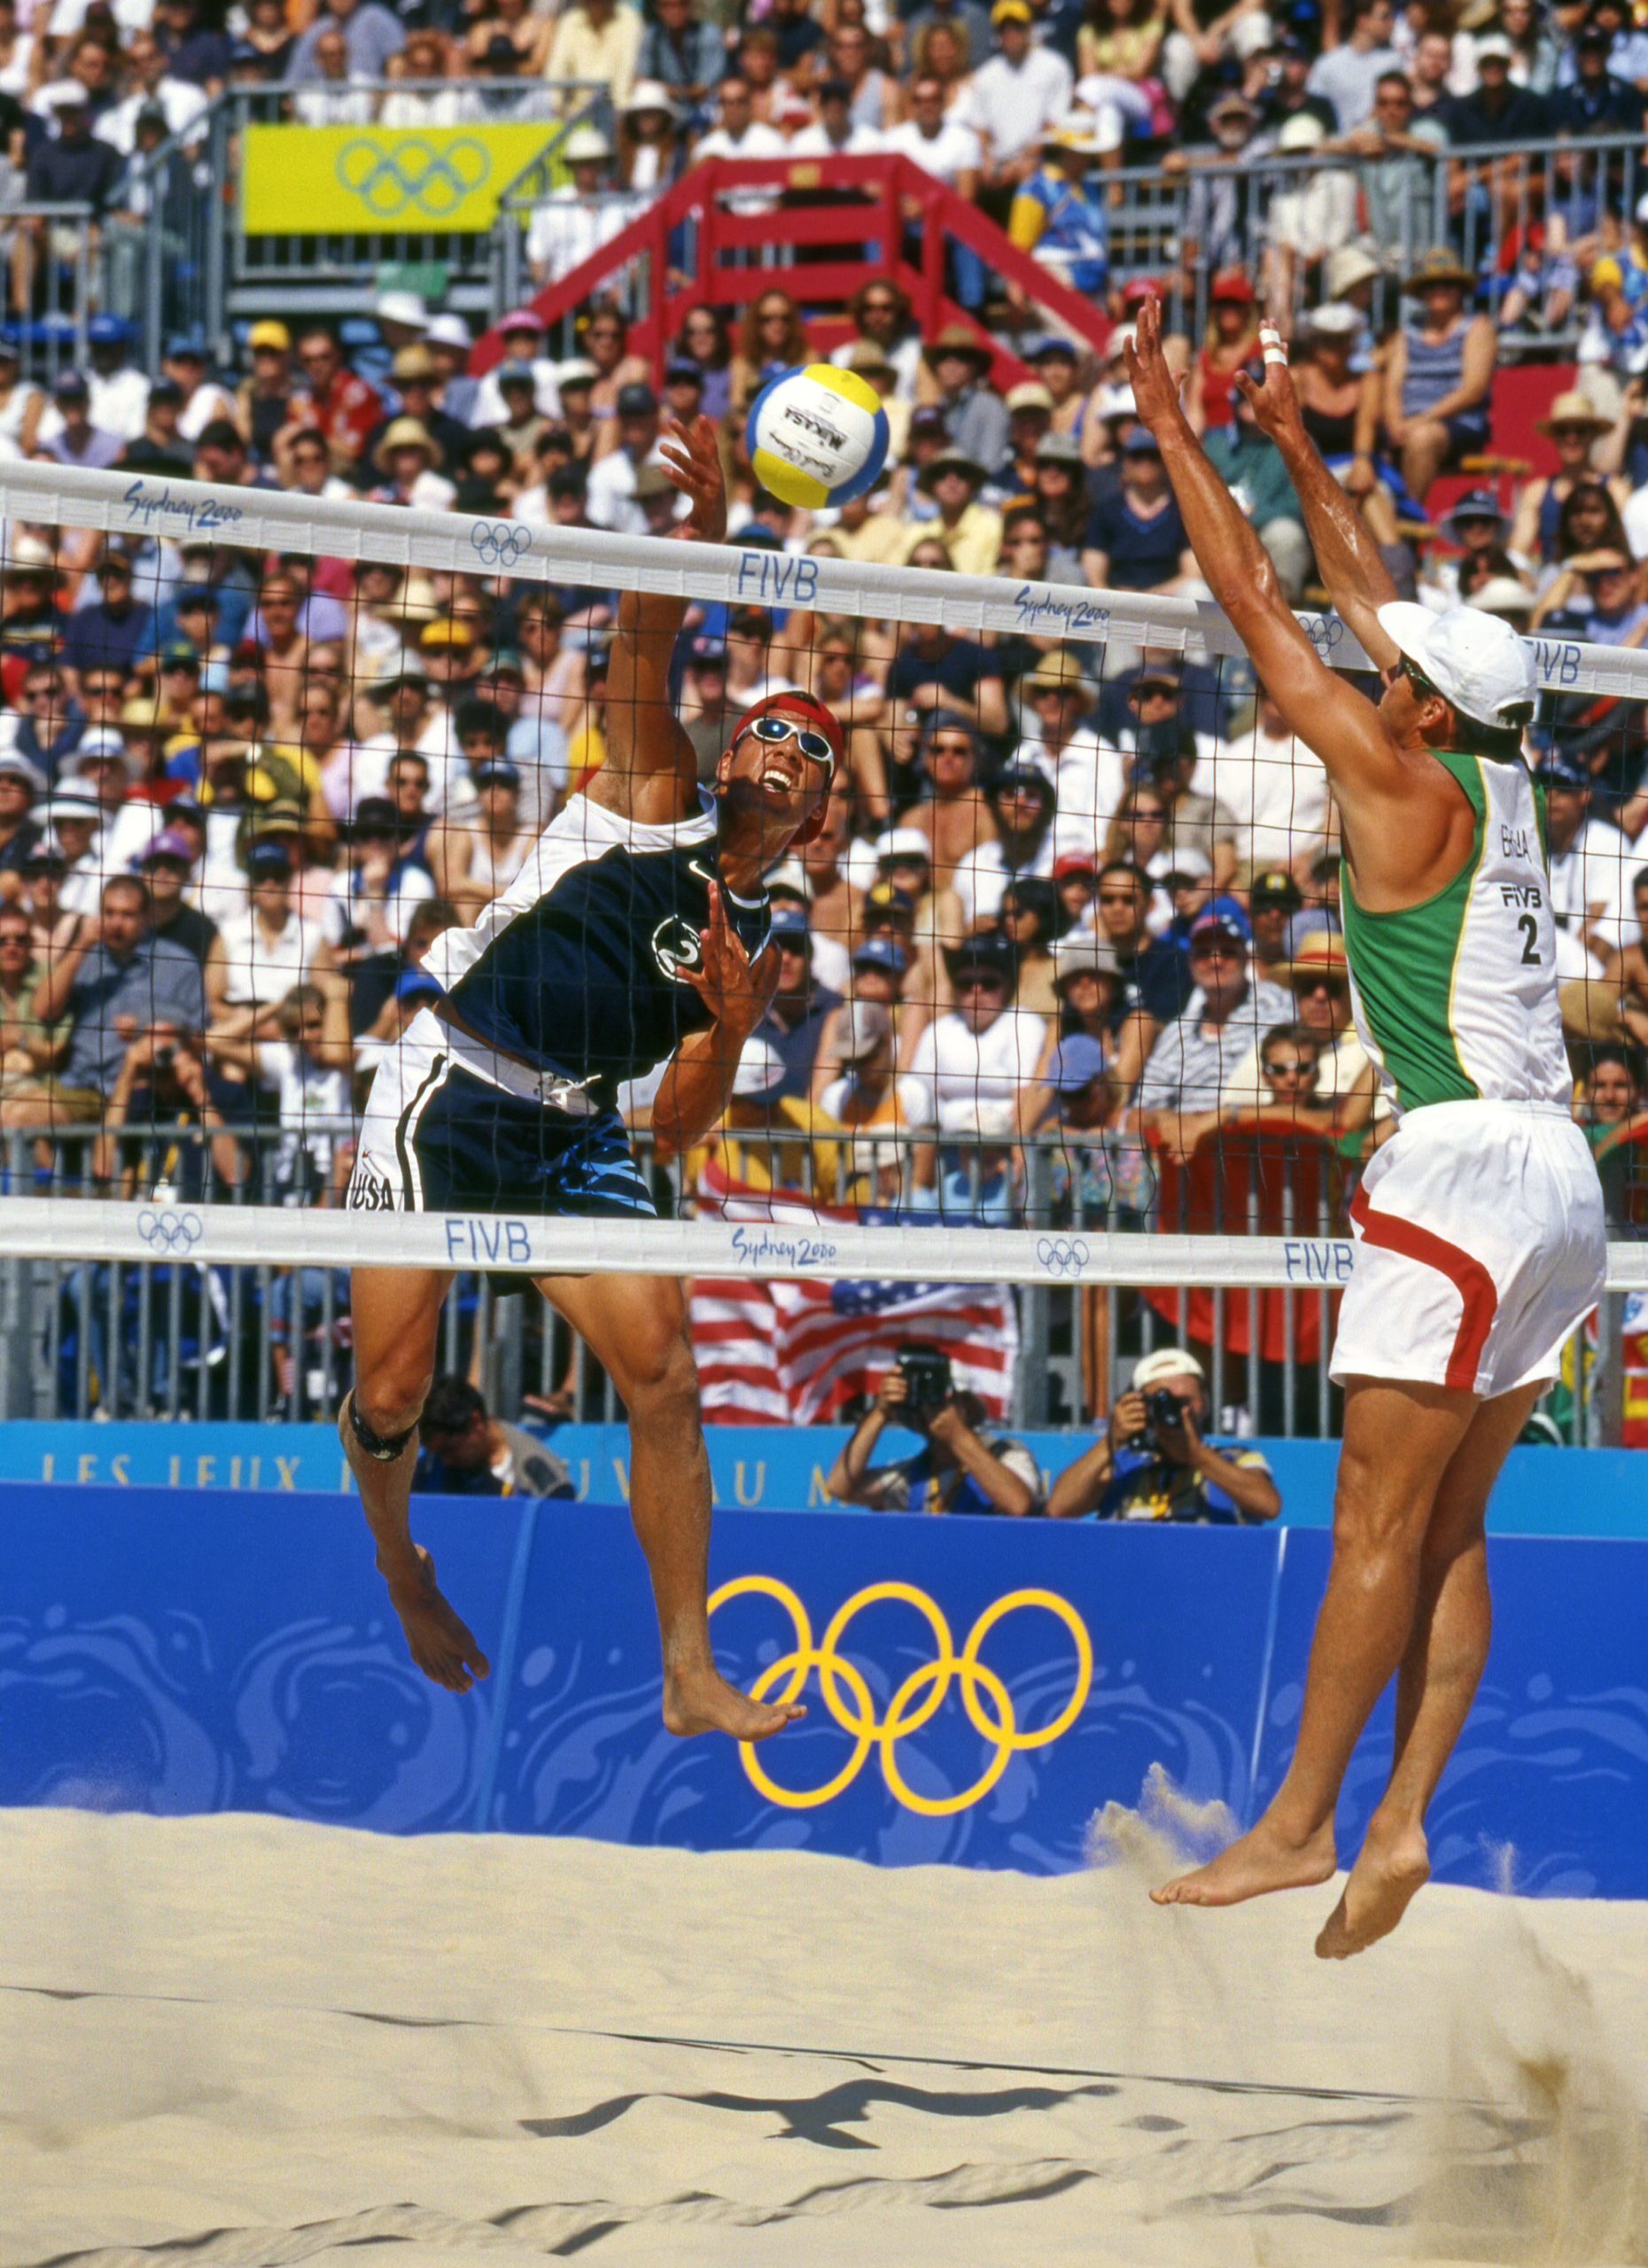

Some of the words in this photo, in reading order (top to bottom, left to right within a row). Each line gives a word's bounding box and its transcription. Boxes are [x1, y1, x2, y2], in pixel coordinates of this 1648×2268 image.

[124, 479, 196, 532] Sydney
[197, 499, 243, 527] 2000
[738, 553, 819, 602] FIVB
[1014, 585, 1072, 632] Sydney
[1072, 602, 1110, 627] 2000
[1524, 640, 1582, 684] IVB
[1518, 913, 1542, 965] 2
[352, 1173, 395, 1212] USA
[445, 1218, 532, 1263] FIVB
[732, 1226, 796, 1269] Sydney
[797, 1239, 836, 1265] 2000
[1285, 1243, 1354, 1281] FIVB
